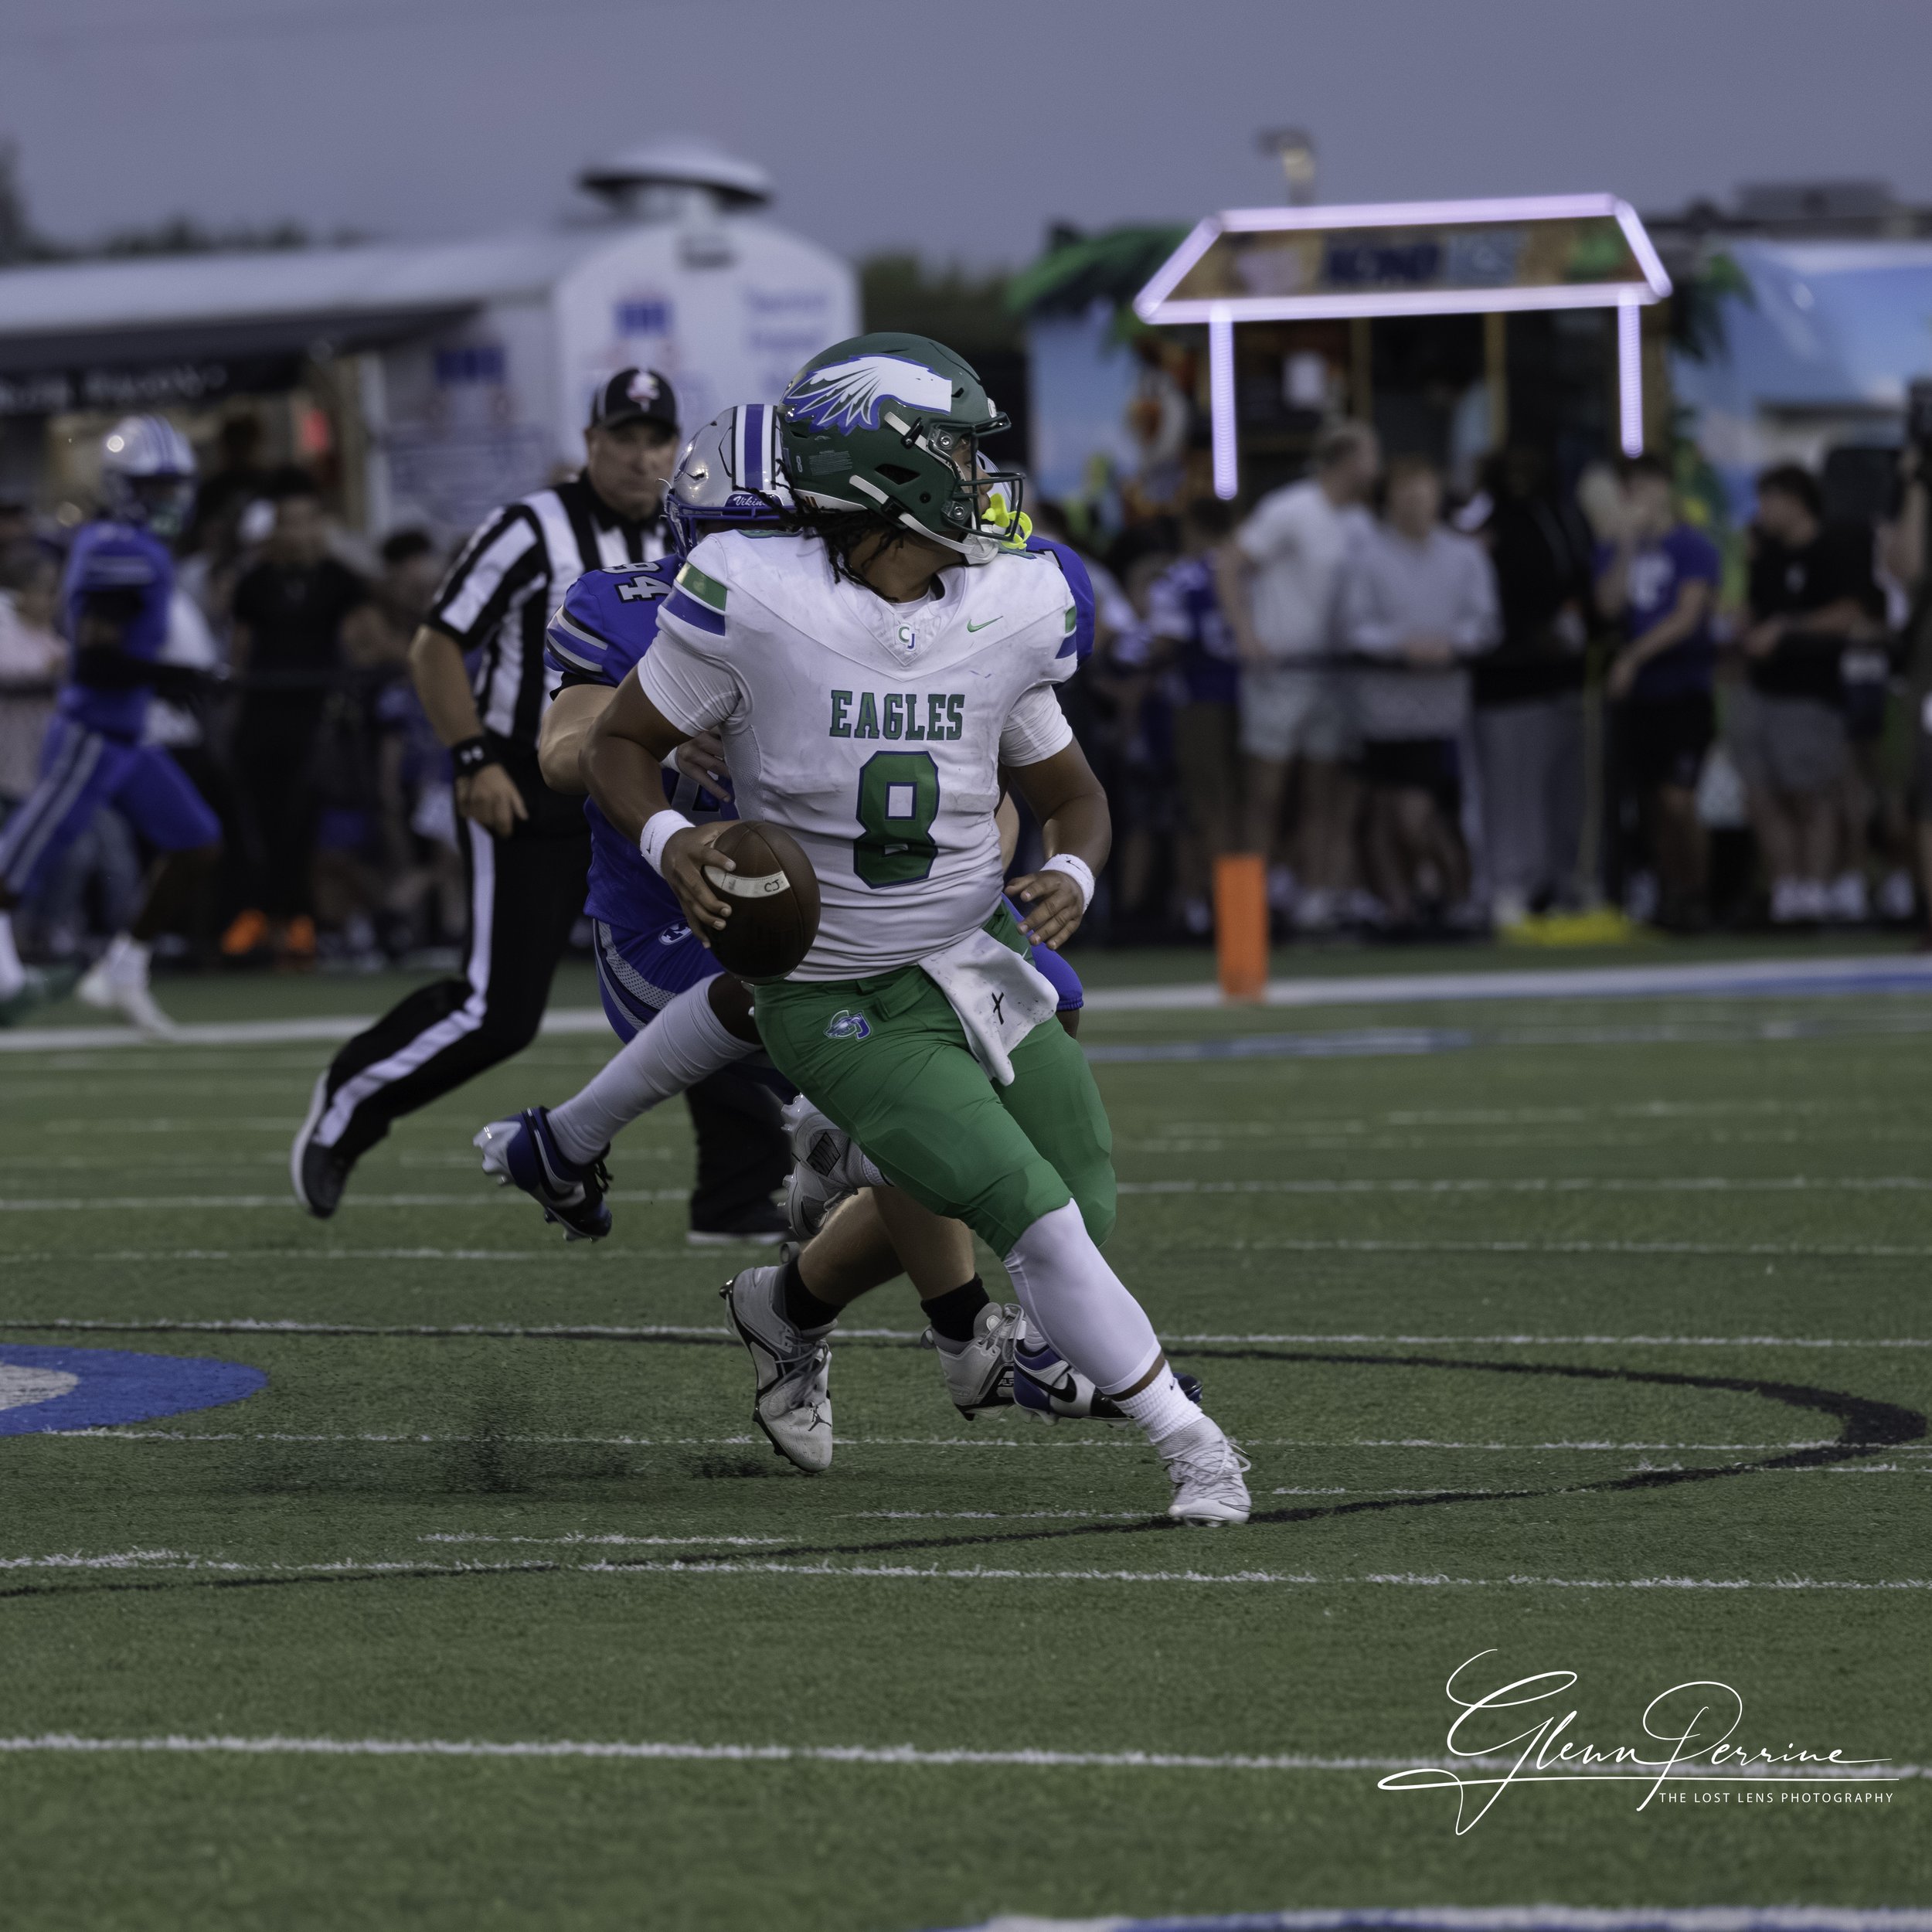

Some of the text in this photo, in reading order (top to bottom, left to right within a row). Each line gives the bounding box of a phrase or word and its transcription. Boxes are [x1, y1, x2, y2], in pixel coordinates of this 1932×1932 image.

[733, 495, 767, 506] Vikin
[829, 689, 965, 741] EAGLES
[853, 750, 940, 889] 8
[764, 879, 781, 893] CJ
